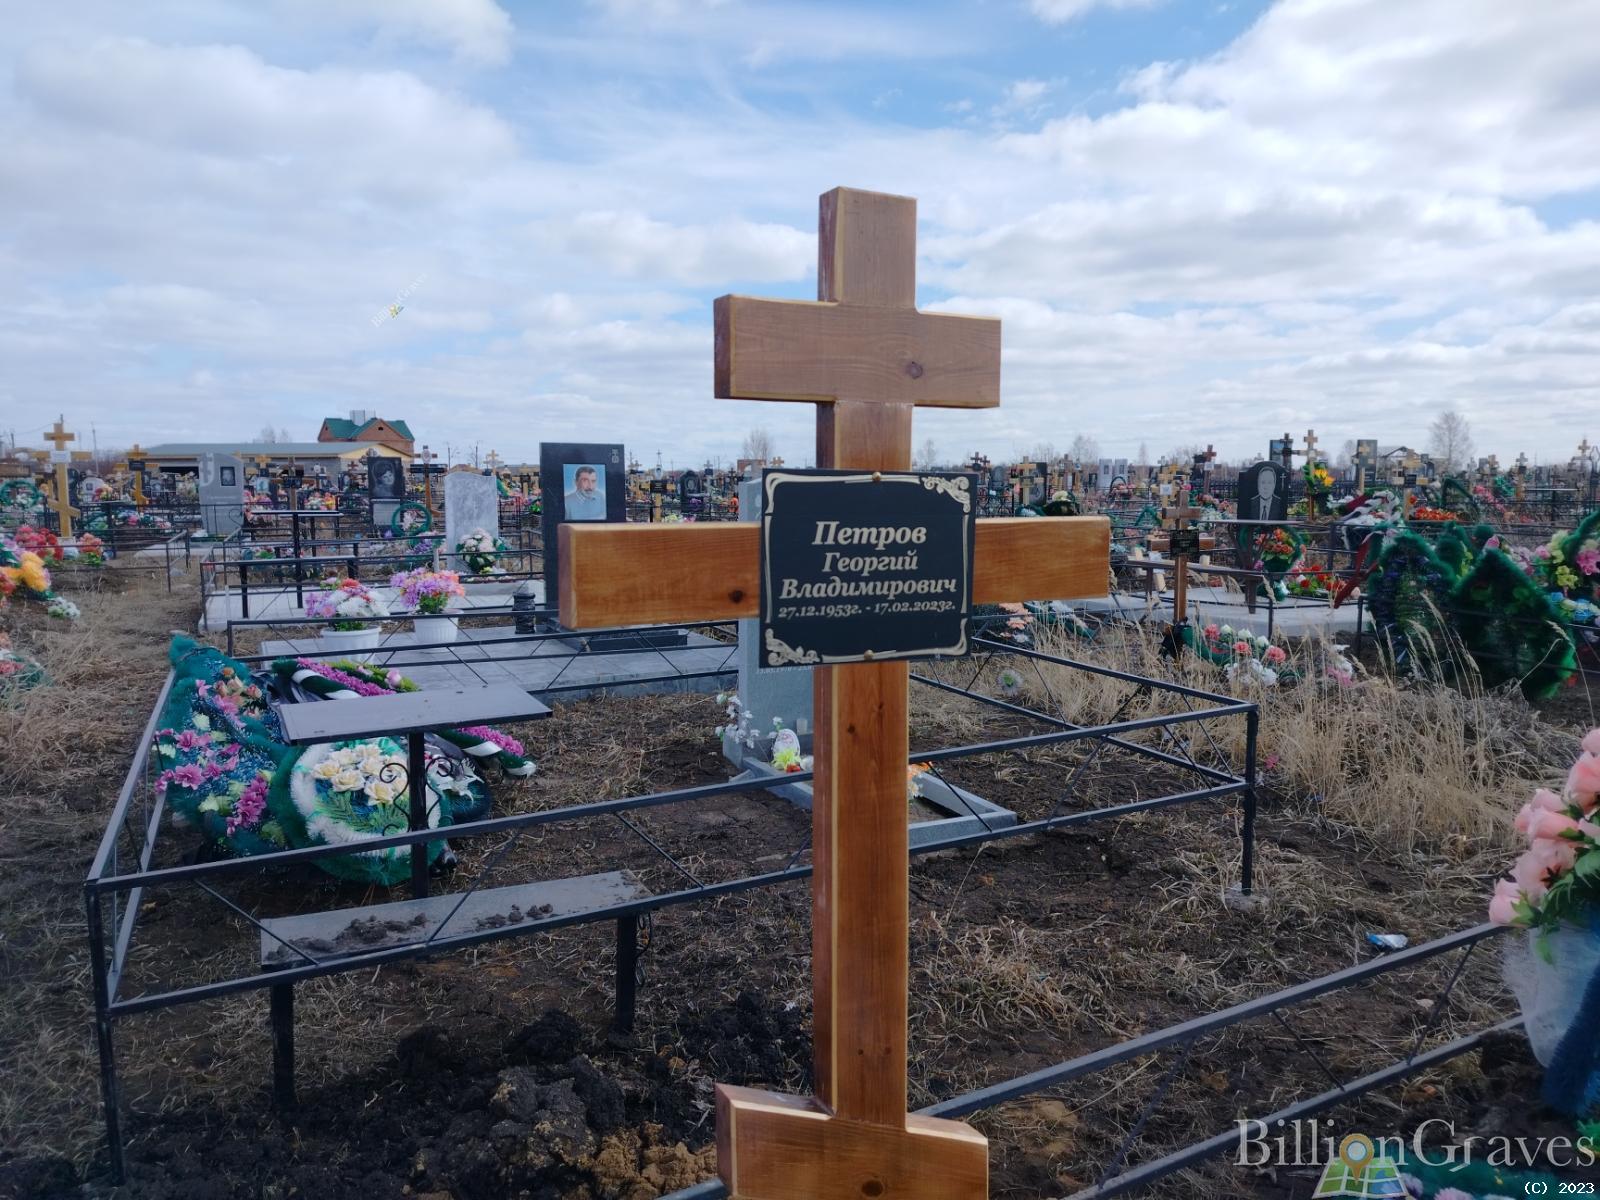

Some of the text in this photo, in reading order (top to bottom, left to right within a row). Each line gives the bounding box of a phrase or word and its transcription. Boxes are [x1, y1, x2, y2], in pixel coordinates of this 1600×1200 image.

[812, 521, 927, 550] Петров
[822, 550, 918, 576] Георгий
[779, 576, 957, 600] Владимирович
[778, 603, 862, 620] 27.12.1953г.
[874, 601, 956, 615] 17.02.2023г.
